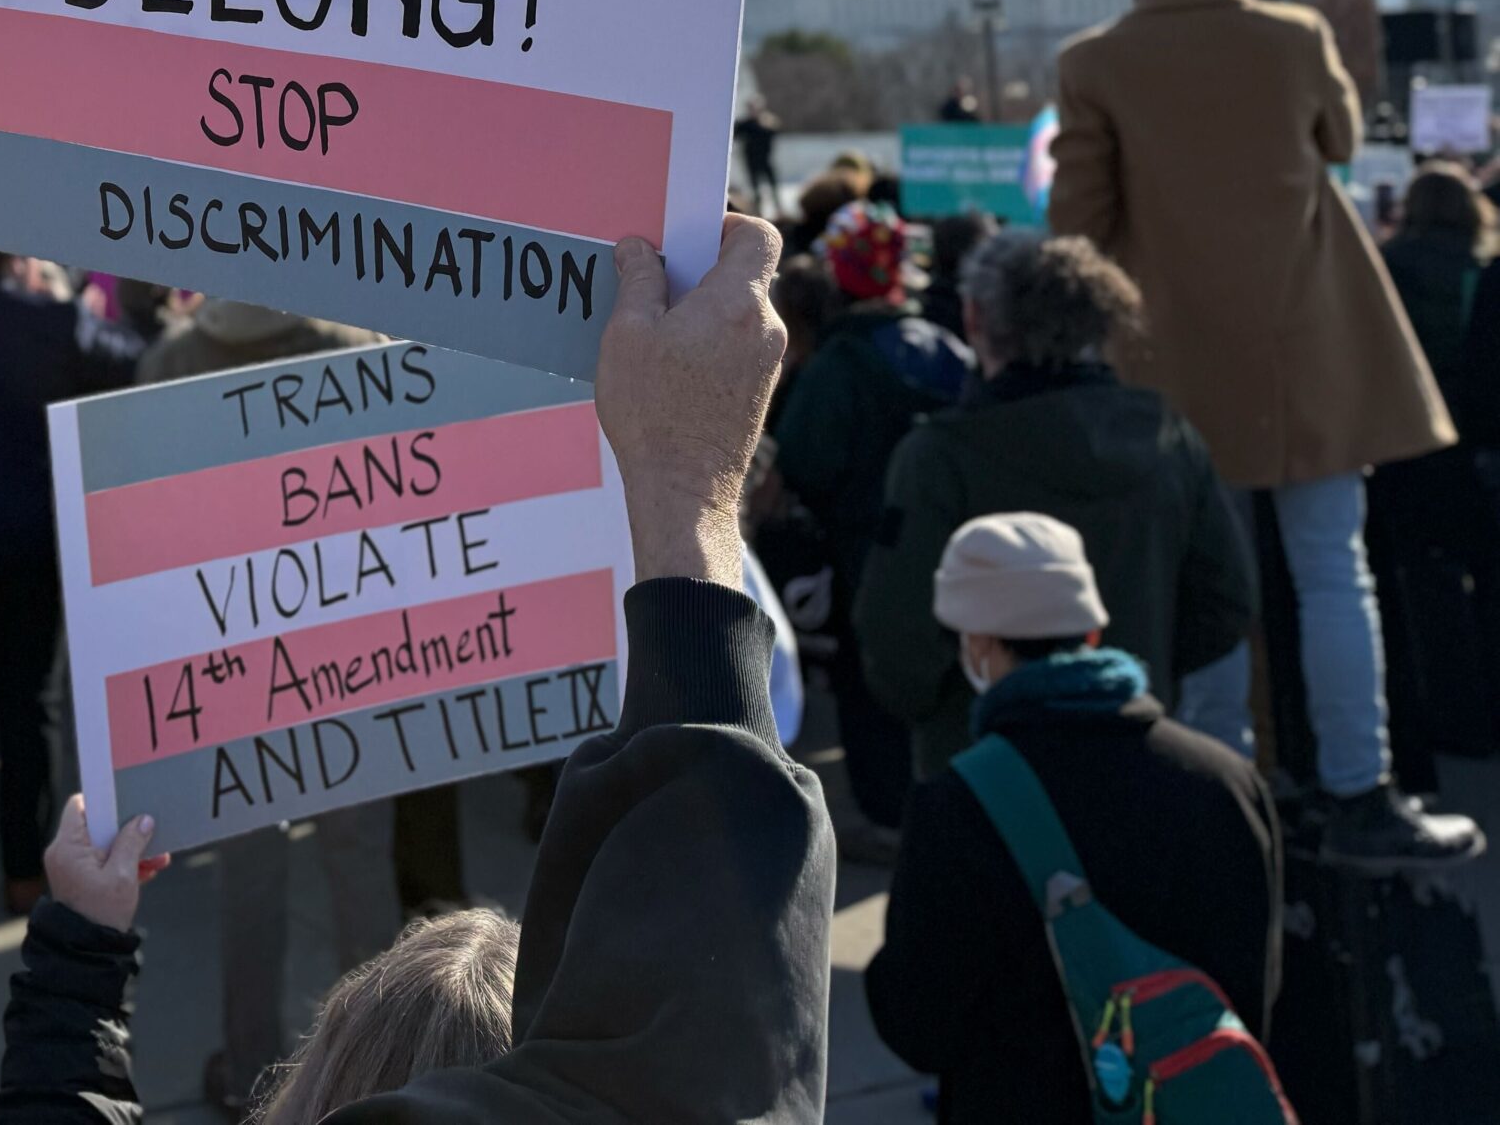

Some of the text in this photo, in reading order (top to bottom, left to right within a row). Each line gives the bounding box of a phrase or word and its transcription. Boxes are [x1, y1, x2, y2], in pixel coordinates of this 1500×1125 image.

[199, 67, 360, 156] STOP
[99, 181, 599, 322] DISCRIMINATION
[222, 346, 437, 437] TRANS
[280, 431, 442, 527] BANS
[196, 508, 500, 637] VIOLATE
[143, 591, 518, 752] 14th Amendment
[211, 717, 361, 820] AND
